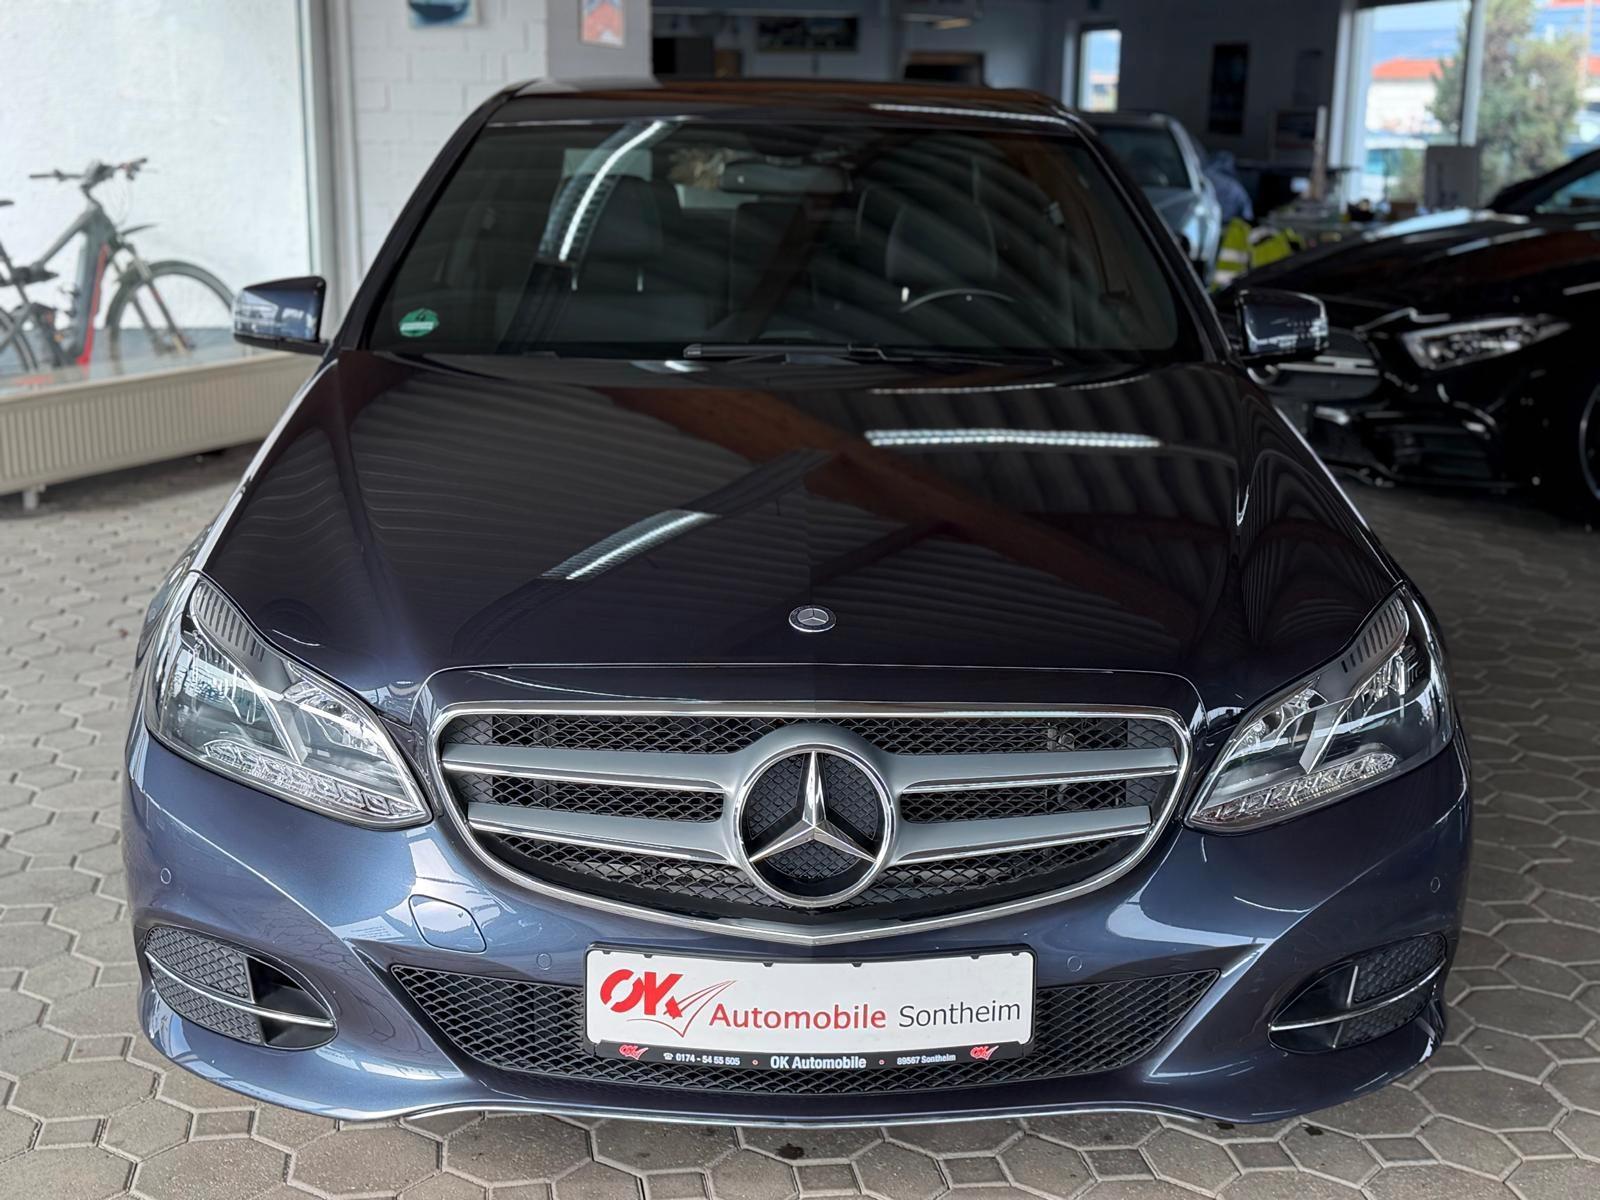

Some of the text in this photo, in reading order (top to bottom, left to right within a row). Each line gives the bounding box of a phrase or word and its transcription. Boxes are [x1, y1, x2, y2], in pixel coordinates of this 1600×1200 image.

[600, 968, 684, 1020] OK
[709, 1000, 1021, 1030] Automobile Sontheim
[675, 1053, 695, 1063] 0174
[702, 1055, 713, 1064] 54
[713, 1056, 725, 1065] 55
[770, 1056, 867, 1070] OK Automobile
[921, 1053, 956, 1064] Sontheim
